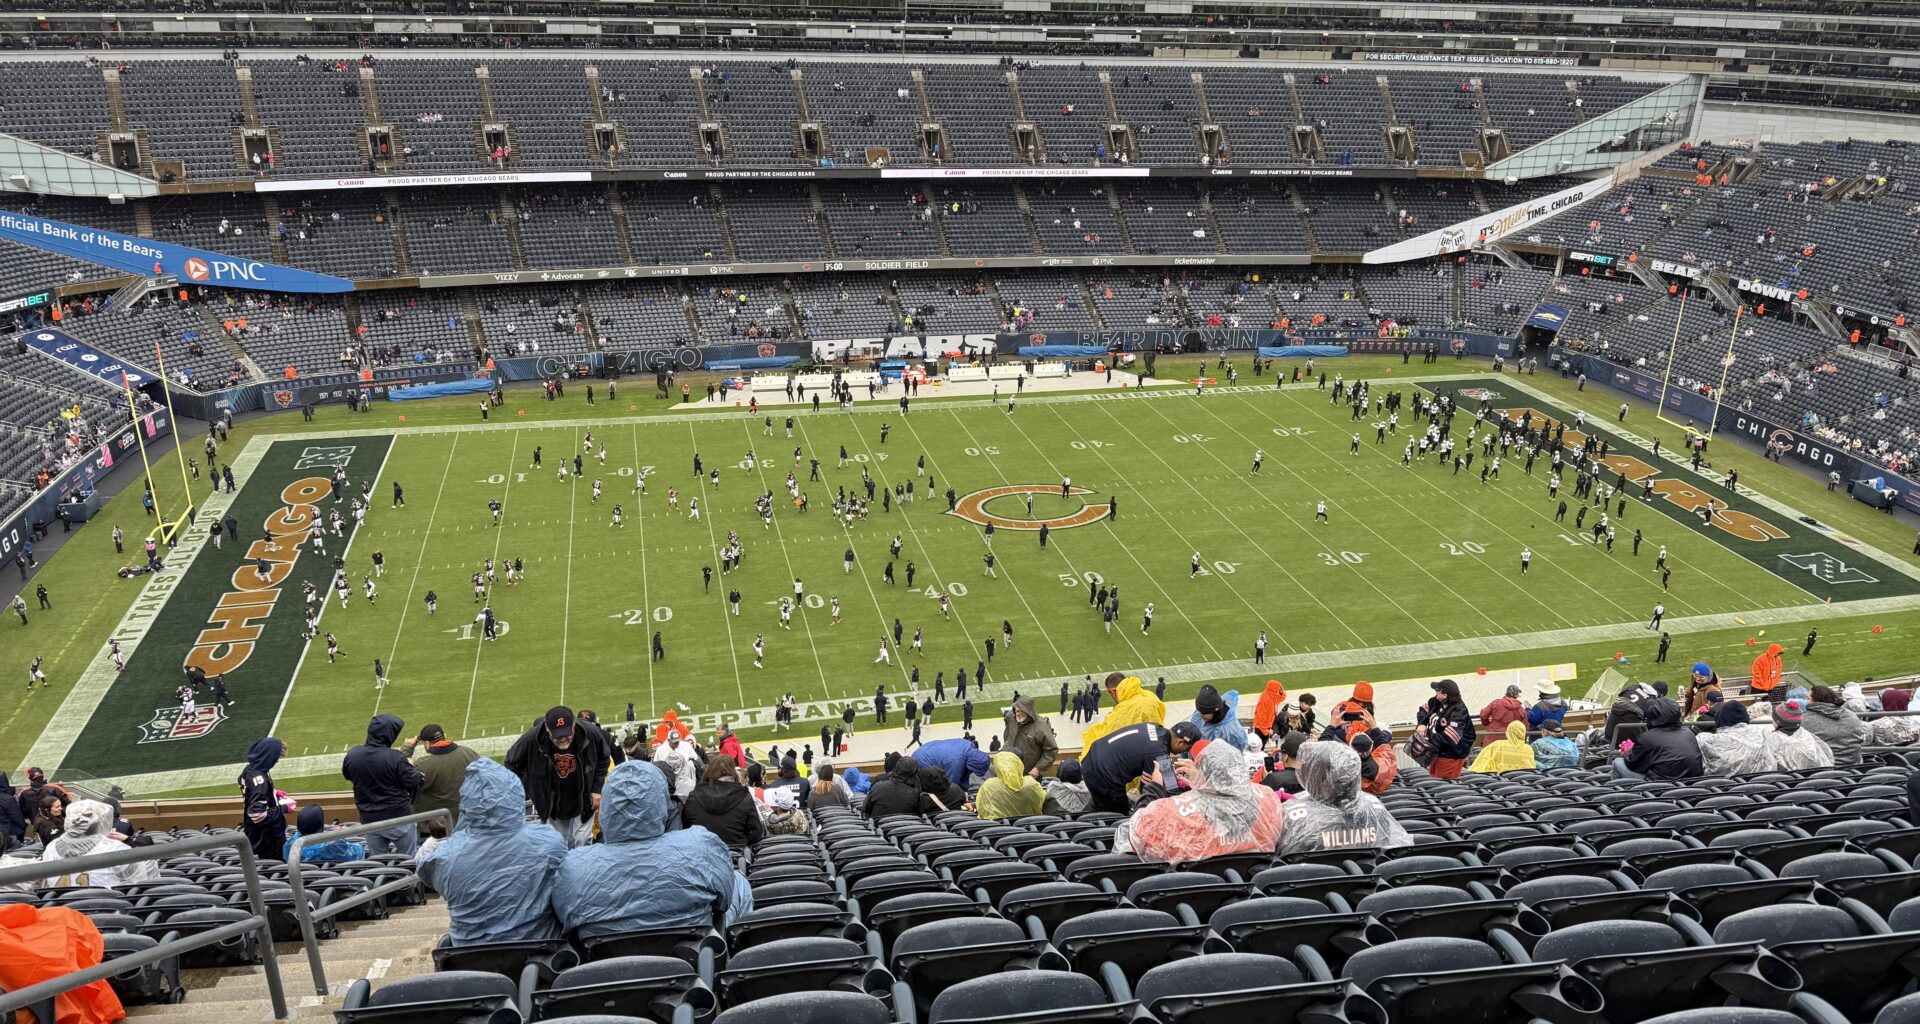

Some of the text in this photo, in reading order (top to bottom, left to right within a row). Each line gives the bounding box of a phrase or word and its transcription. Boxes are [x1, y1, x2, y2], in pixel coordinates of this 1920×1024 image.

[1494, 203, 1534, 237] Miller
[1527, 205, 1548, 221] TIME,
[1551, 191, 1583, 211] CHICAGO
[0, 215, 163, 260] fficial Bank of the Bears
[865, 261, 929, 270] SOLDIER FIELD
[1174, 257, 1216, 265] ticketmaster
[1594, 255, 1614, 264] BET
[211, 260, 266, 281] PNC
[551, 272, 584, 280] Advocate
[1651, 260, 1792, 302] BEAR DOWN
[28, 292, 49, 306] BET
[811, 333, 997, 363] BEARS
[1091, 388, 1194, 400] INTERCEPT
[1173, 433, 1208, 443] 30
[1272, 427, 1309, 437] 20
[1070, 440, 1103, 450] 40
[1737, 417, 1834, 466] CHICAGO
[854, 452, 889, 463] 40
[964, 446, 1000, 457] 50
[488, 472, 529, 484] 10
[191, 501, 228, 528] US
[1439, 541, 1486, 556] 20
[1316, 550, 1363, 566] 30
[183, 476, 333, 679] CHICAGO
[1057, 571, 1105, 587] 50
[127, 570, 182, 621] TAKES
[924, 582, 968, 599] 40
[623, 606, 673, 625] 20
[112, 624, 146, 643] IT
[456, 620, 510, 641] 10
[253, 775, 264, 787] 15
[1320, 827, 1378, 849] WILLIAMS
